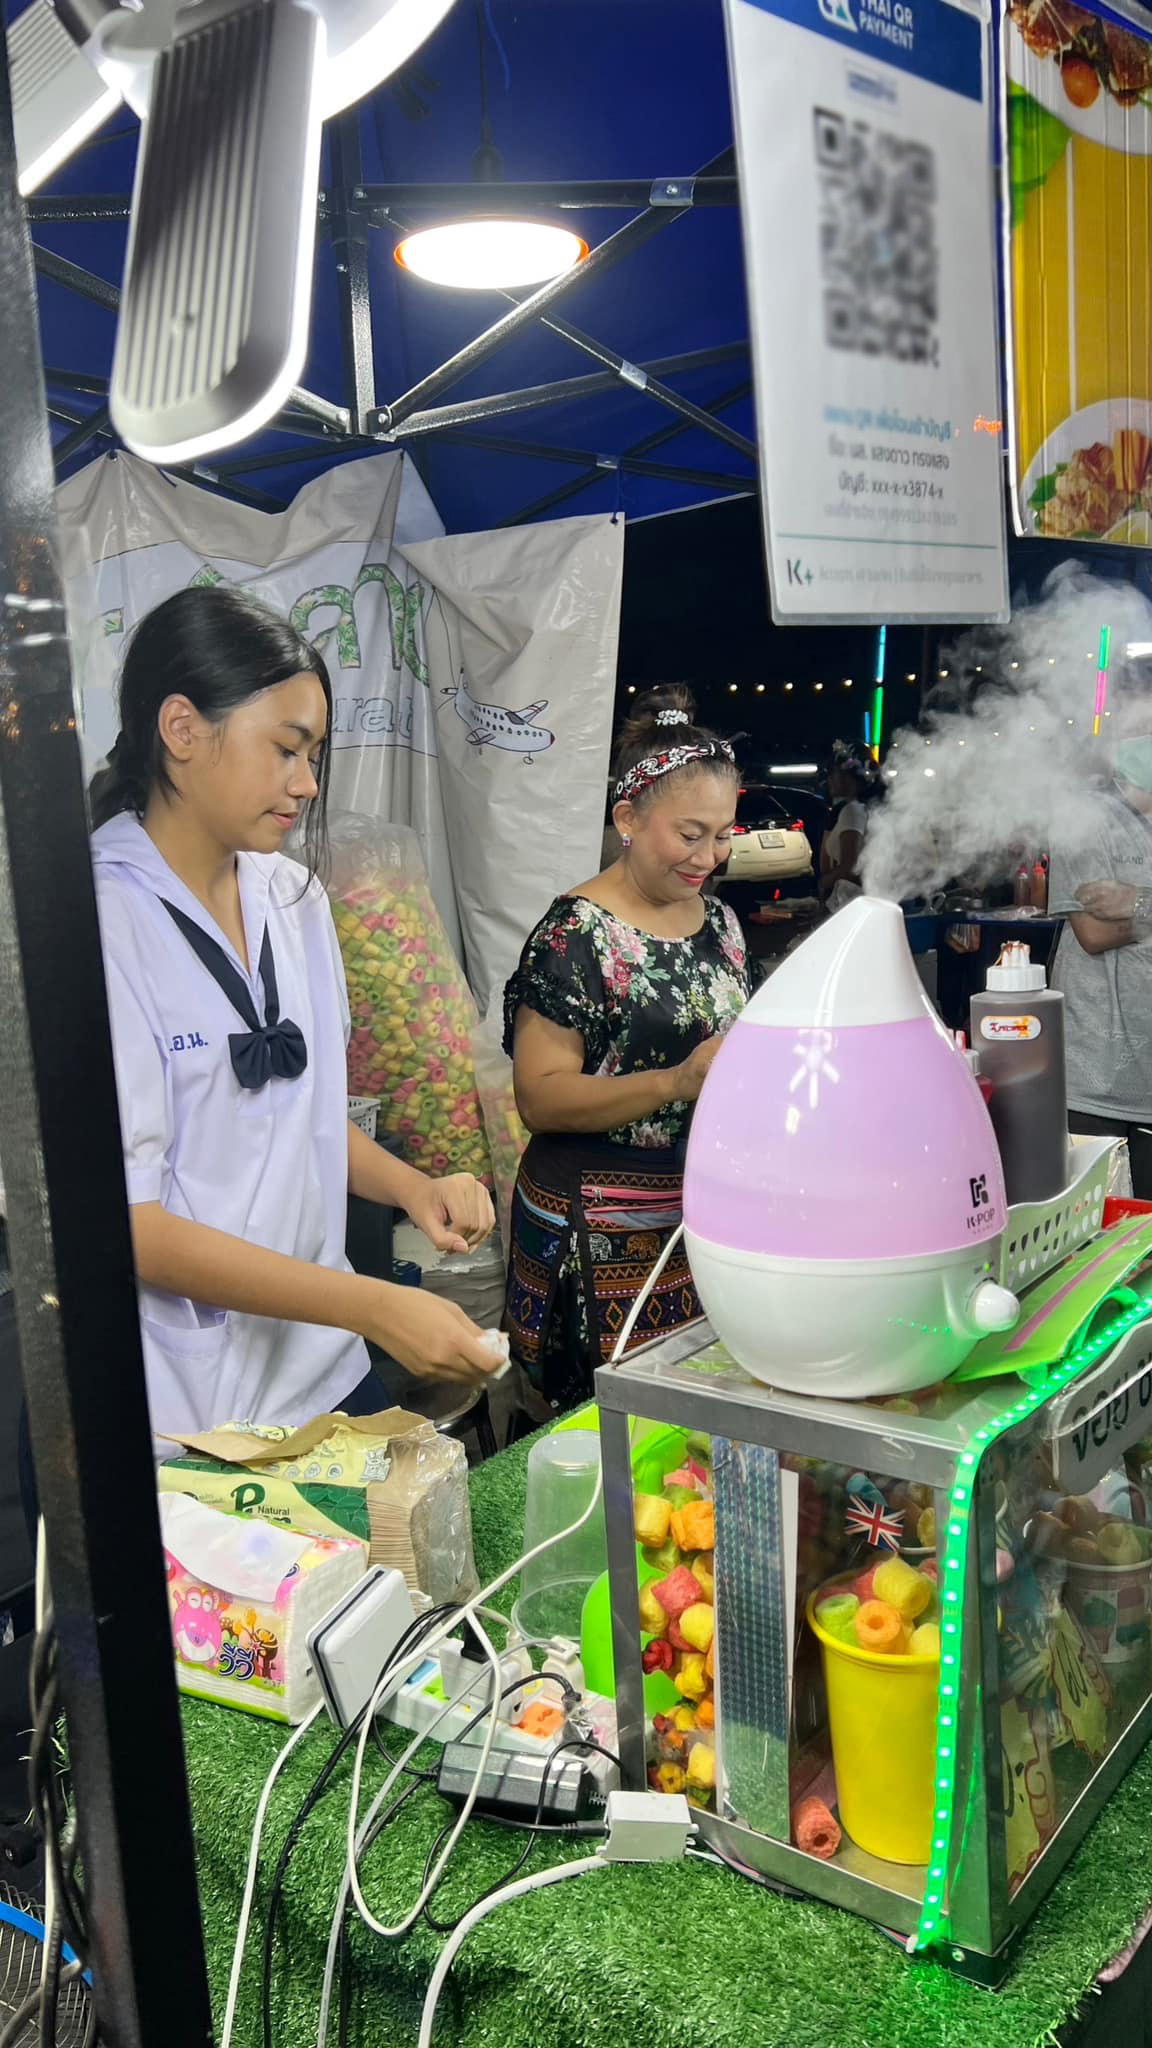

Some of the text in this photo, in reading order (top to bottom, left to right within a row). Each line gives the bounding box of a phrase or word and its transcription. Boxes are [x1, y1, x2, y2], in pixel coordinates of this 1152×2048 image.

[894, 3, 913, 30] QR
[860, 11, 914, 50] PAYMENT
[257, 1505, 290, 1516] Natural
